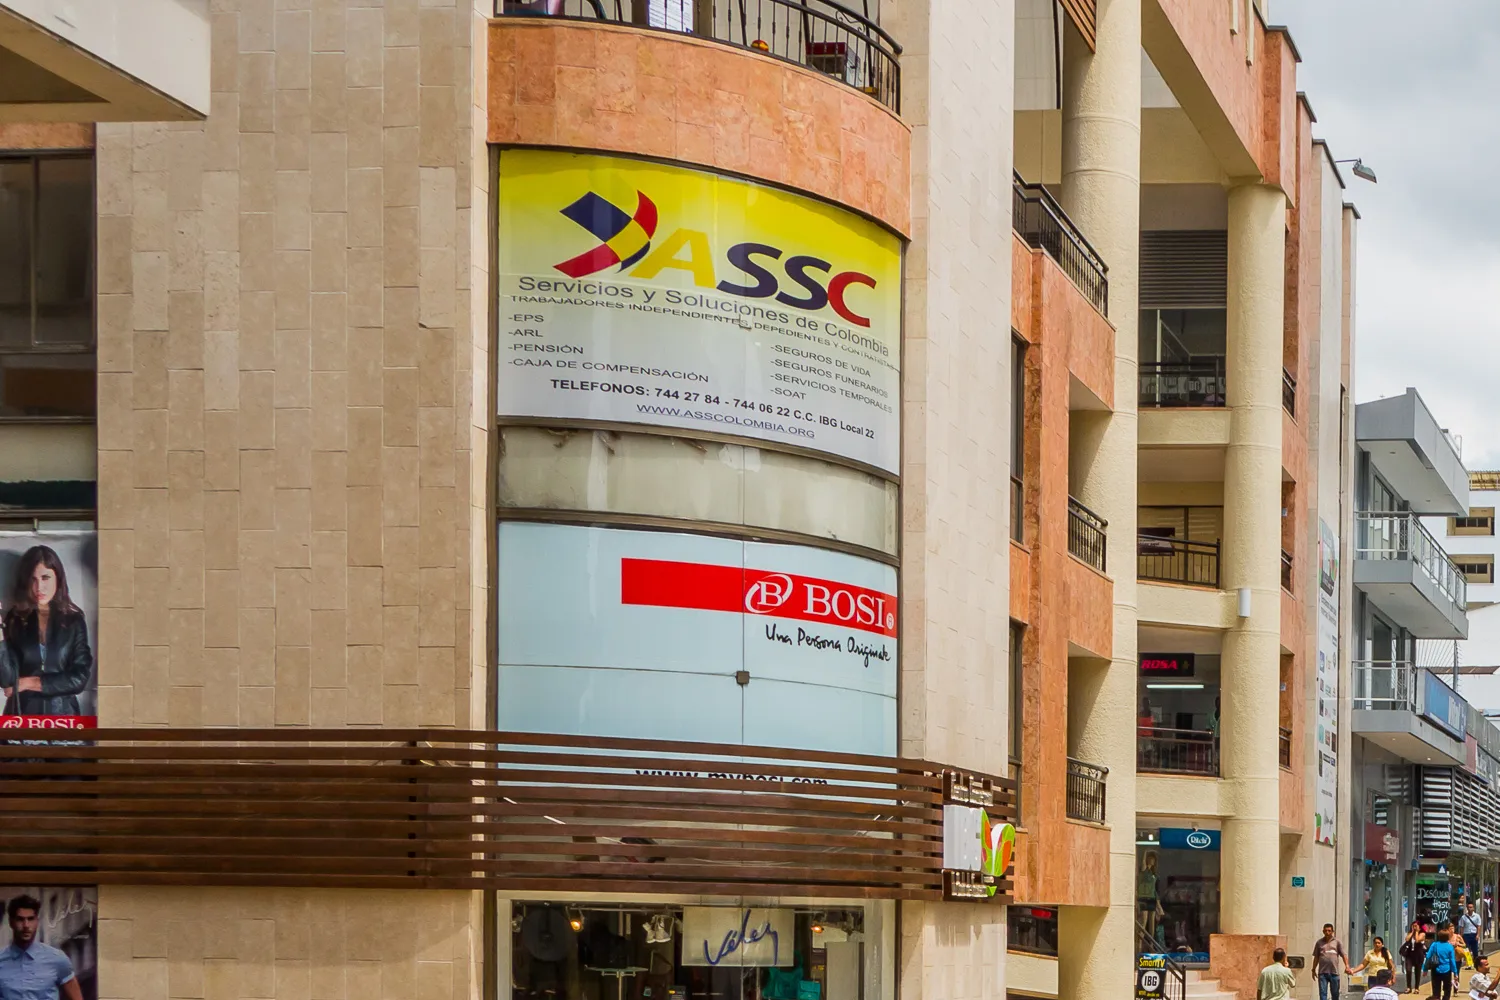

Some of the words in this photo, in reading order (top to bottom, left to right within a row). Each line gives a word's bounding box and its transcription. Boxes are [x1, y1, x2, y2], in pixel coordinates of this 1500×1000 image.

[628, 227, 877, 328] ASSC
[508, 313, 544, 323] -EPS
[508, 328, 544, 338] -ARL
[510, 295, 624, 309] TRABAJADORES
[754, 322, 831, 347] DEPEDIENTES
[518, 276, 633, 298] Servicios
[642, 289, 656, 303] y
[665, 289, 789, 324] Soluciones
[795, 316, 819, 331] de
[825, 322, 889, 357] Colombia
[507, 343, 584, 355] -PENSIÓN
[770, 344, 833, 365] -SEGUROS
[835, 359, 849, 370] DE
[851, 364, 872, 378] VIDA
[507, 358, 553, 368] -CAJA
[556, 360, 577, 369] DE
[582, 361, 709, 383] COMPENSACIÓN
[770, 358, 832, 379] -SEGUROS
[835, 373, 889, 399] FUNERARIOS
[550, 379, 650, 396] TELEFONOS:
[654, 387, 680, 400] 744
[684, 391, 700, 402] 27
[704, 394, 720, 406] 84
[733, 398, 755, 411] 744
[759, 403, 773, 414] 06
[776, 406, 790, 417] 22
[793, 409, 816, 423] C.C.
[819, 414, 838, 428] IBG
[840, 420, 864, 436] Local
[865, 428, 875, 440] 22
[770, 373, 837, 394] -SERVICIOS
[839, 388, 893, 414] TEMPORALES
[770, 387, 807, 401] -SOAT
[636, 404, 816, 439] WWW.ASSCOLOMBIA.ORG
[765, 623, 793, 646] Una
[797, 627, 842, 653] Persona
[1144, 975, 1158, 987] IBG
